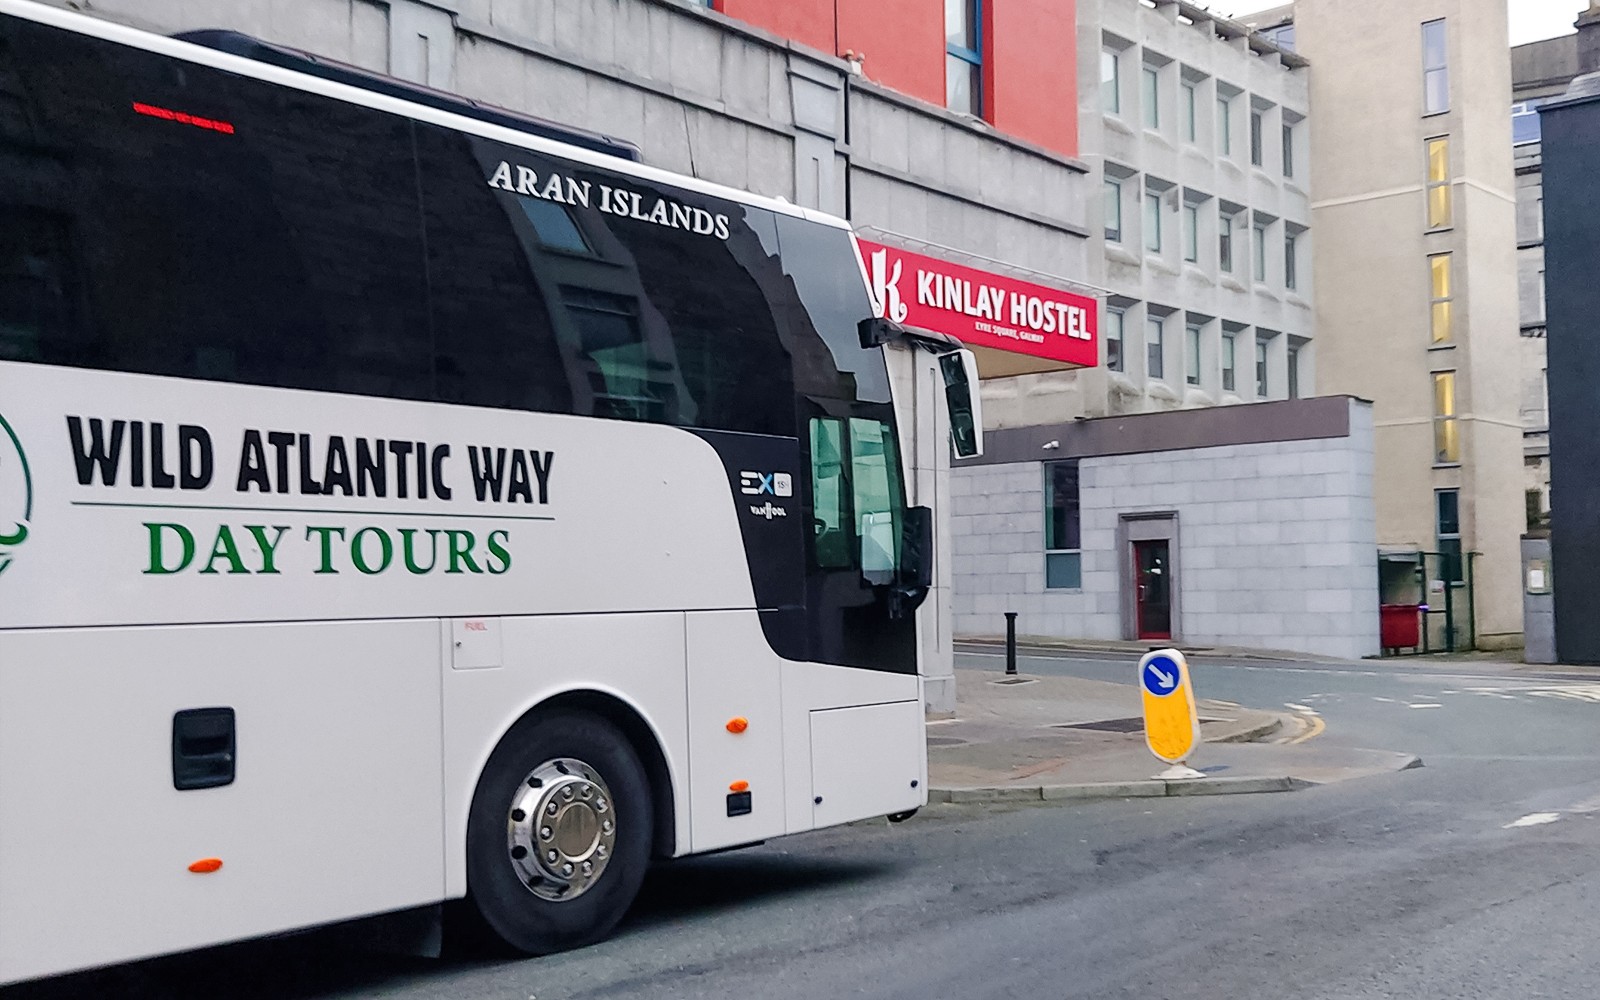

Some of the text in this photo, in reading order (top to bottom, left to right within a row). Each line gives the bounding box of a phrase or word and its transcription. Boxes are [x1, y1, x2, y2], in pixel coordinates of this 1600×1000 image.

[487, 160, 730, 240] ARAN ISLANDS
[917, 269, 1092, 341] KINLAY HOSTEL
[66, 415, 555, 505] WILD ATLANTIC WAY
[142, 522, 512, 575] DAY TOURS
